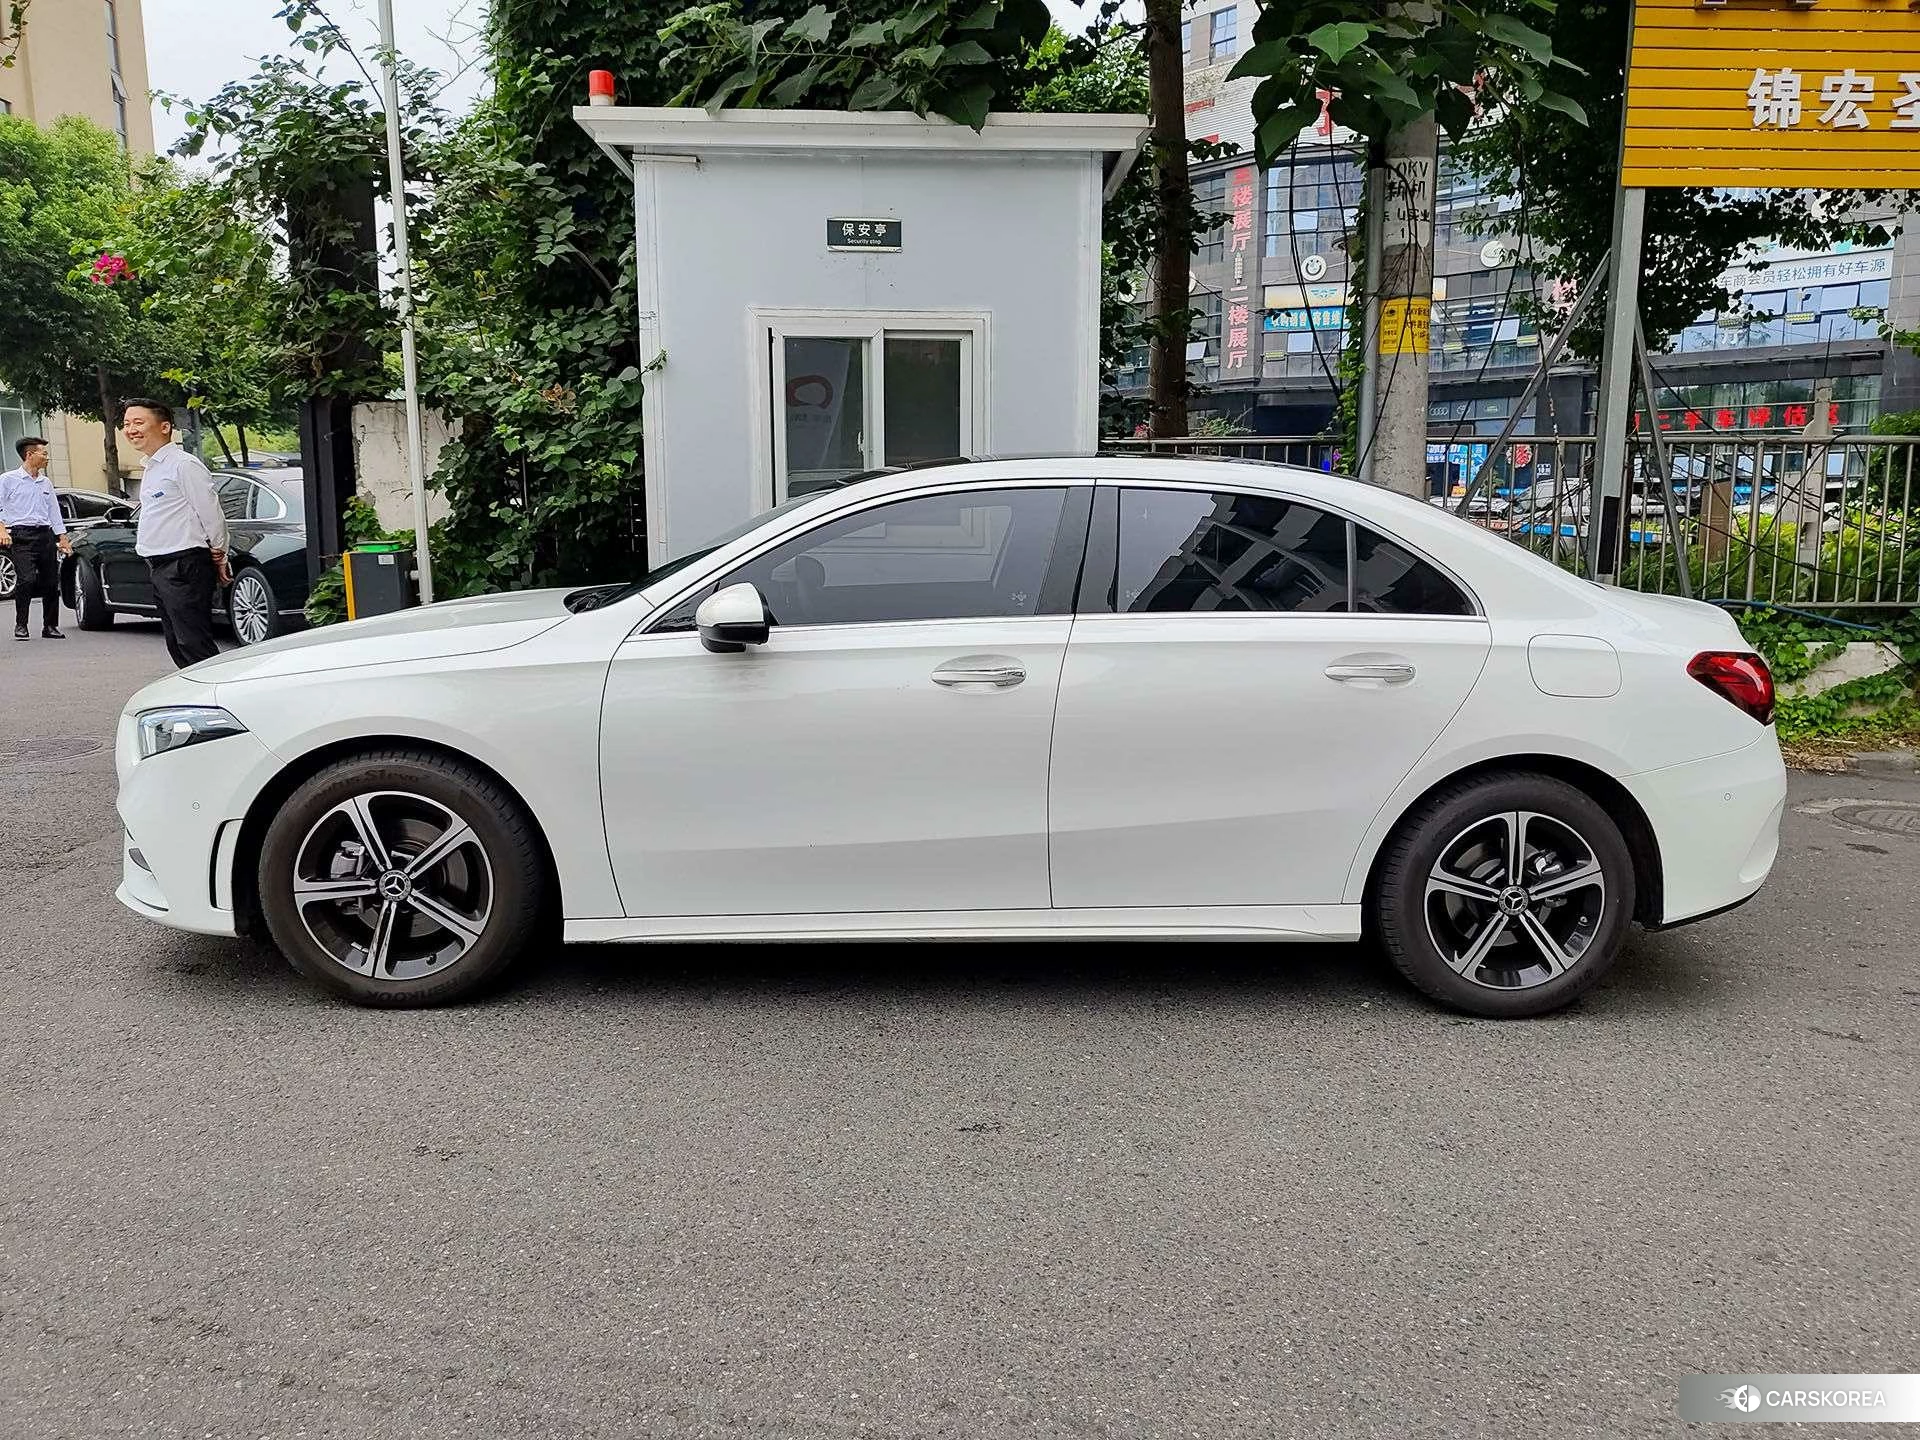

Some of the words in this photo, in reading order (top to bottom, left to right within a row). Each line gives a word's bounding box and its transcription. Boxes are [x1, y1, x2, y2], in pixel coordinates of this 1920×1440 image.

[842, 222, 887, 237] 保安亭
[1231, 167, 1253, 253] 三楼展厅
[1227, 285, 1249, 369] 二楼展厅
